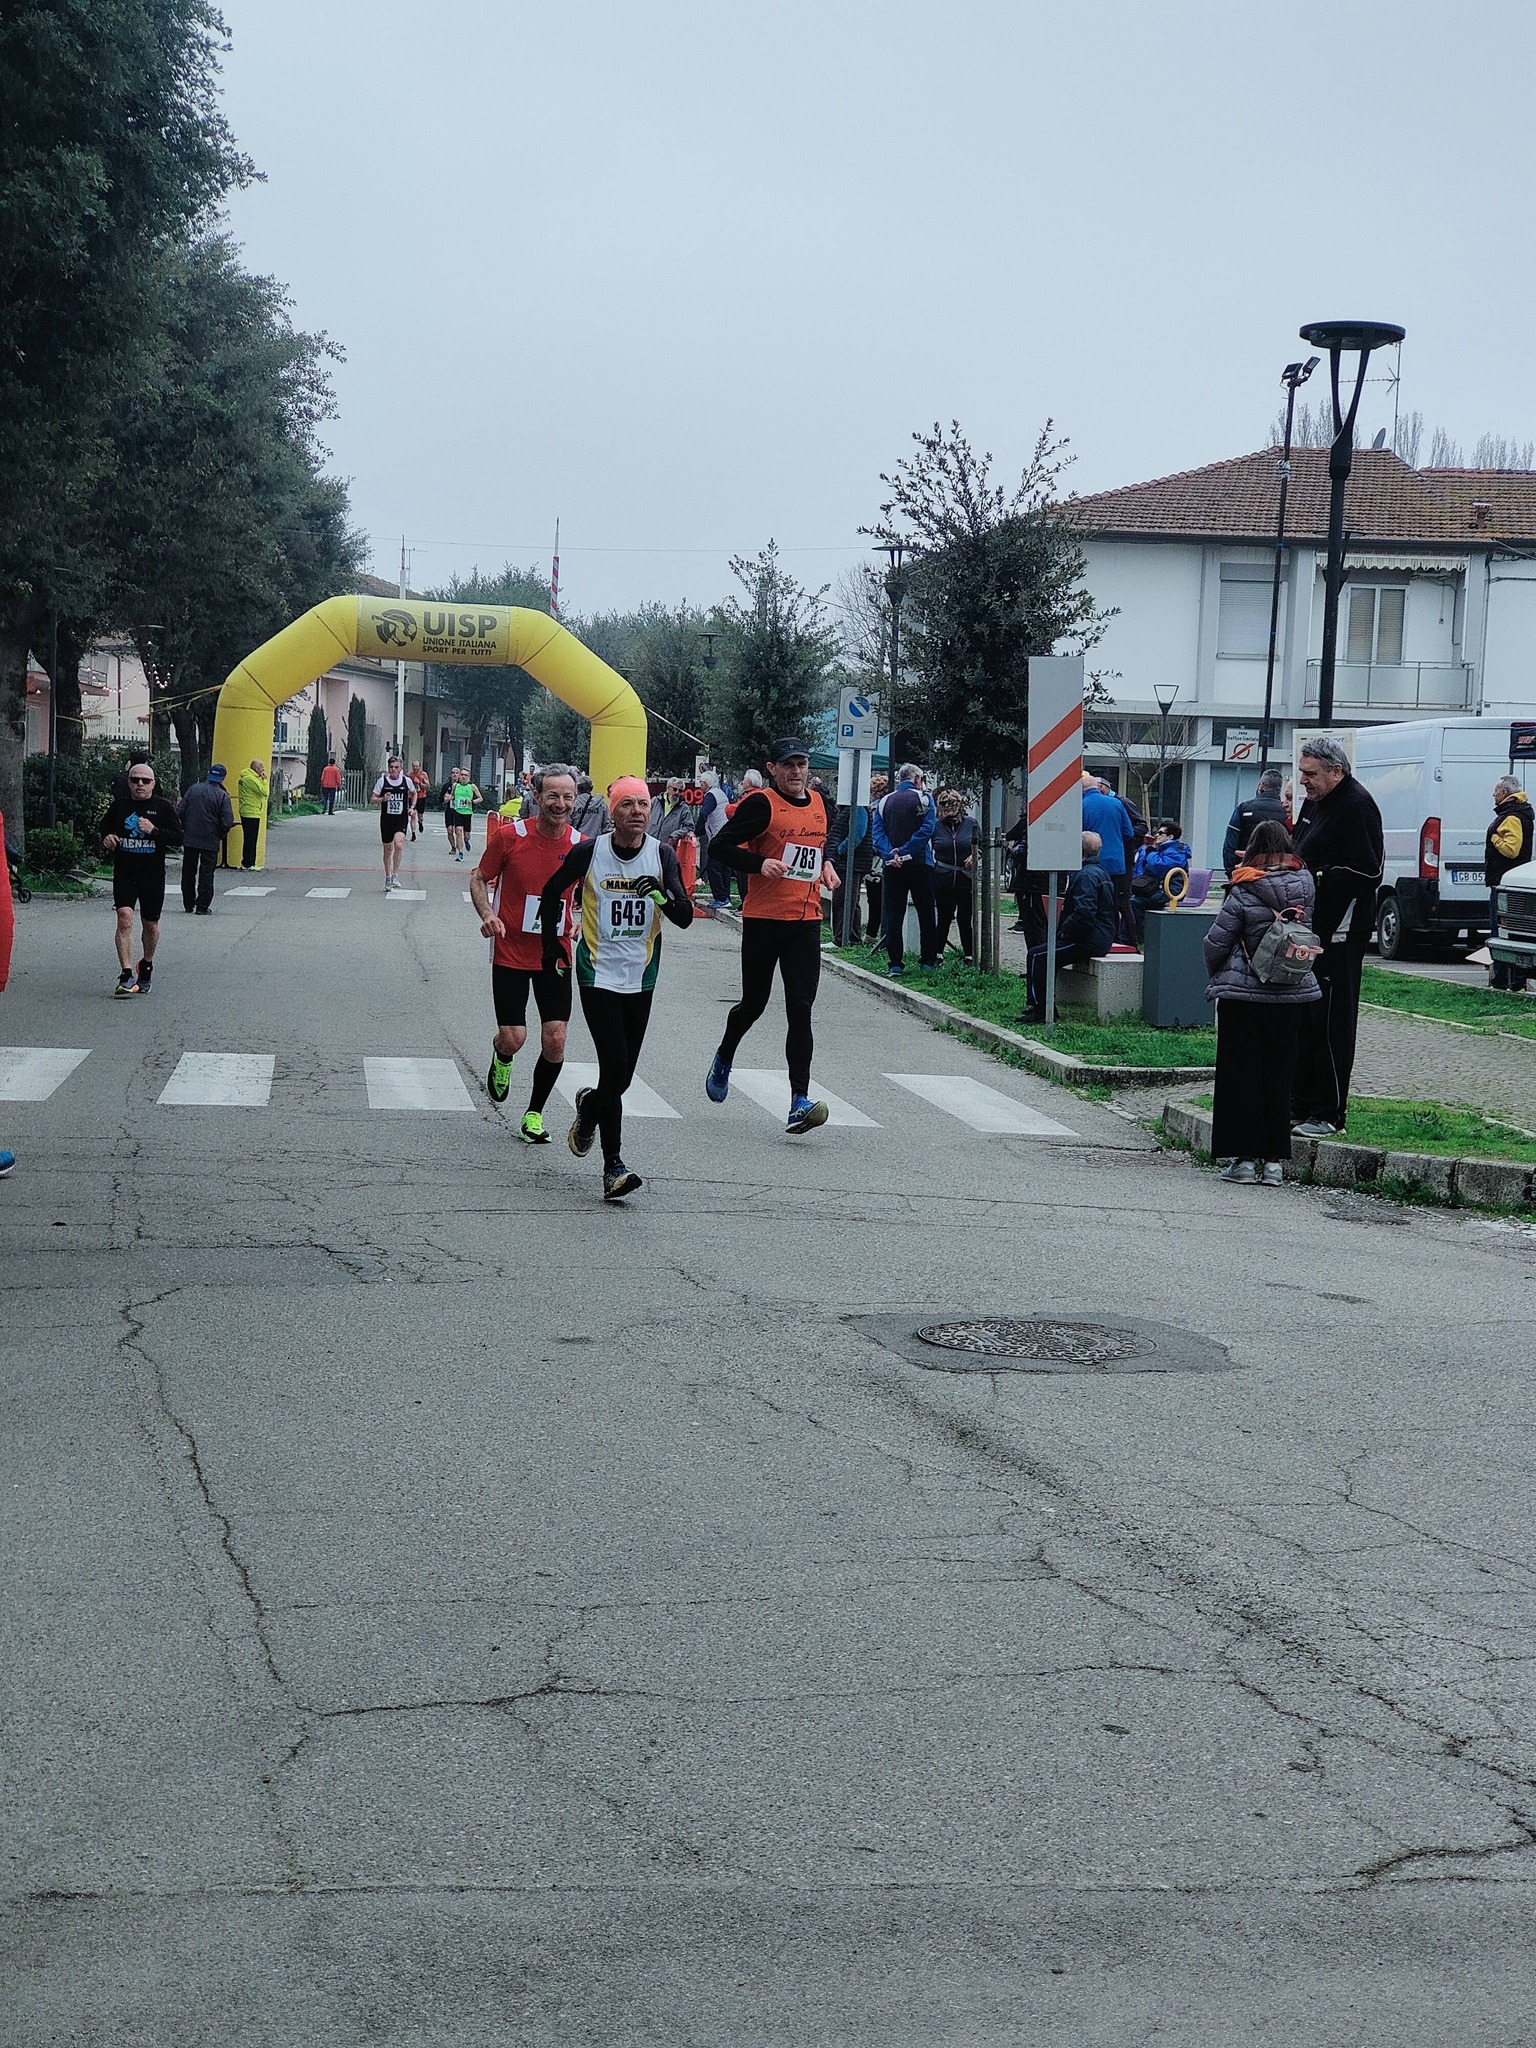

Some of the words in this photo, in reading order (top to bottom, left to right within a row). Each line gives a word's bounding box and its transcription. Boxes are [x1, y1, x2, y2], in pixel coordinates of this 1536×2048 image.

[423, 611, 497, 638] UISP
[422, 646, 449, 654] SPORT
[423, 637, 456, 647] UNIONE
[459, 640, 497, 649] ITALIANA
[791, 846, 816, 870] 783
[611, 900, 646, 926] 643
